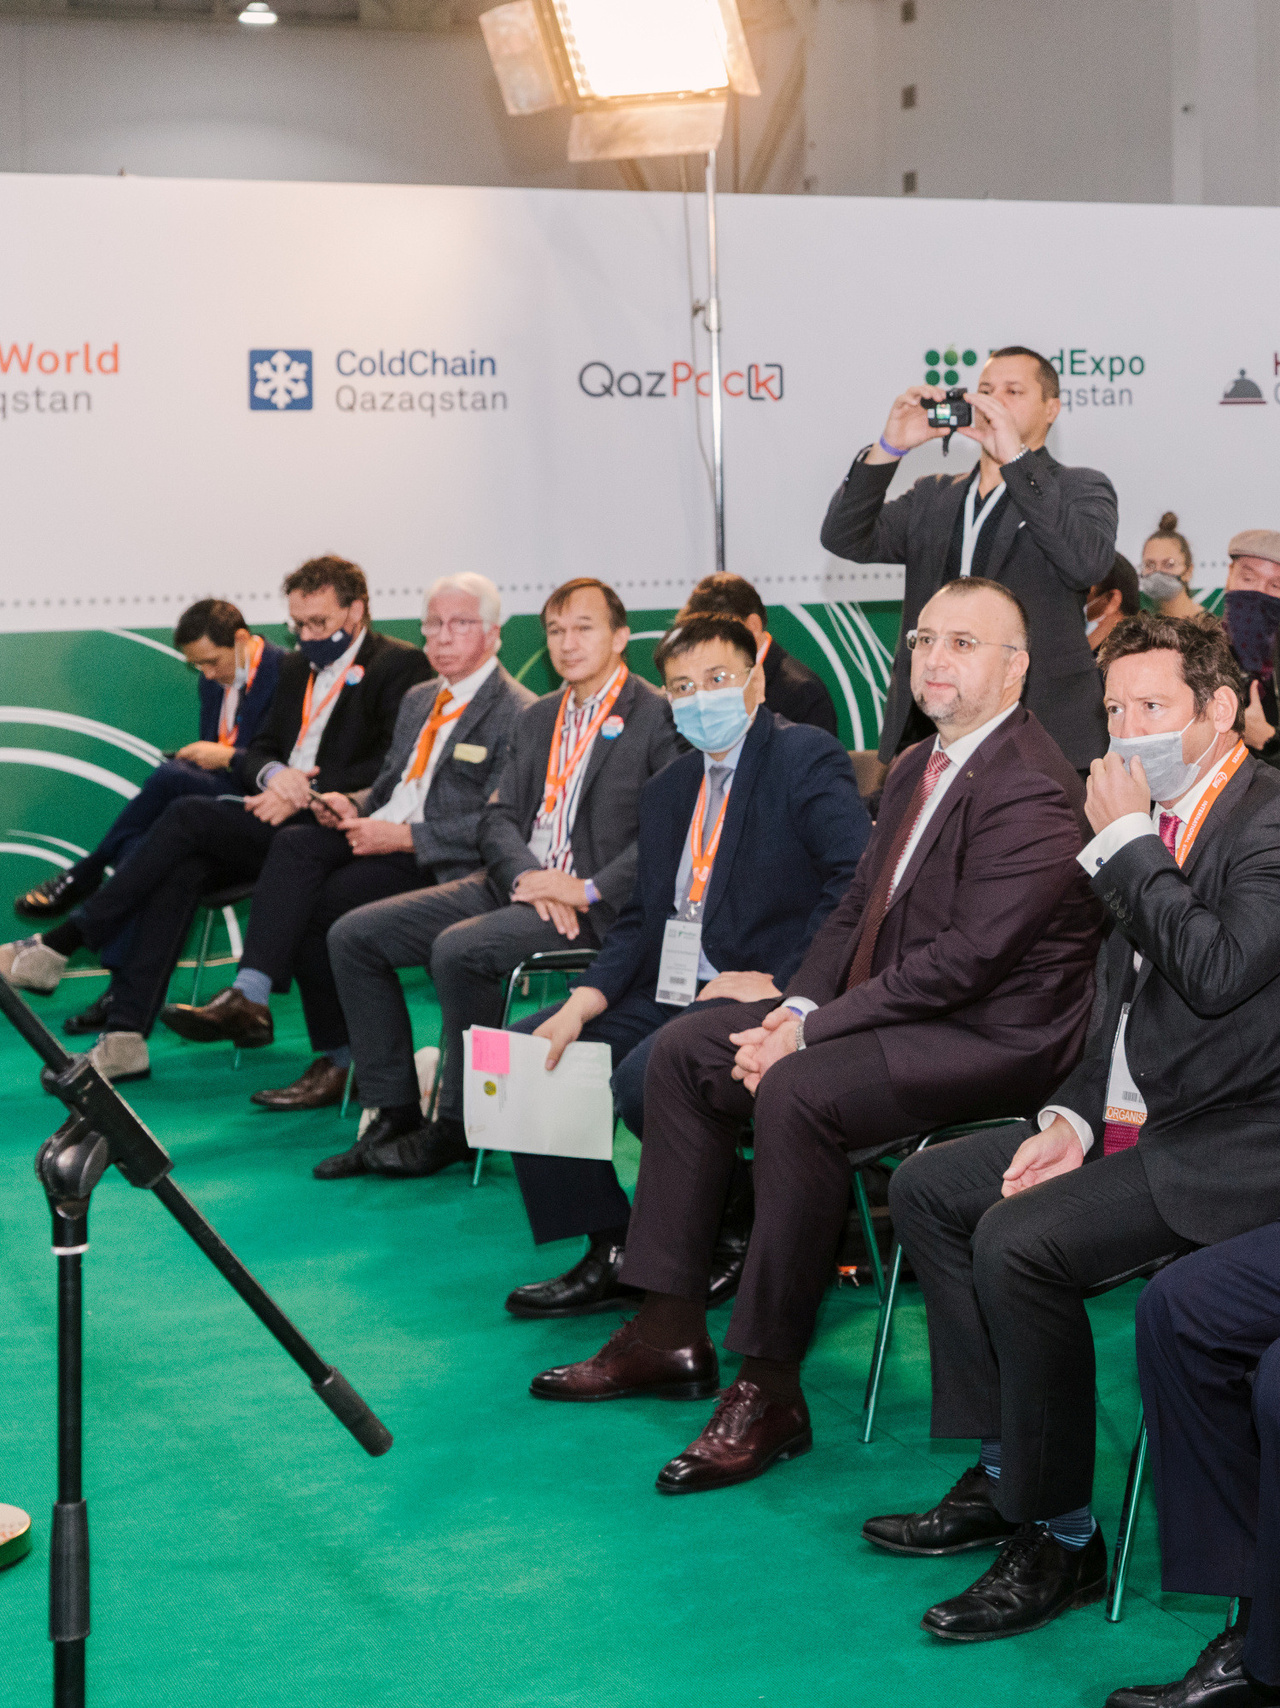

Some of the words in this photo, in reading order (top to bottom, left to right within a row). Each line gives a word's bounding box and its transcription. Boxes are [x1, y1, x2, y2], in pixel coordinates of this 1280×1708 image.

[0, 341, 119, 374] World
[336, 349, 497, 376] ColdChain
[1048, 349, 1145, 382] dExpo
[335, 384, 508, 418] Qazaqstan
[1184, 800, 1209, 843] INTERNATIONAL
